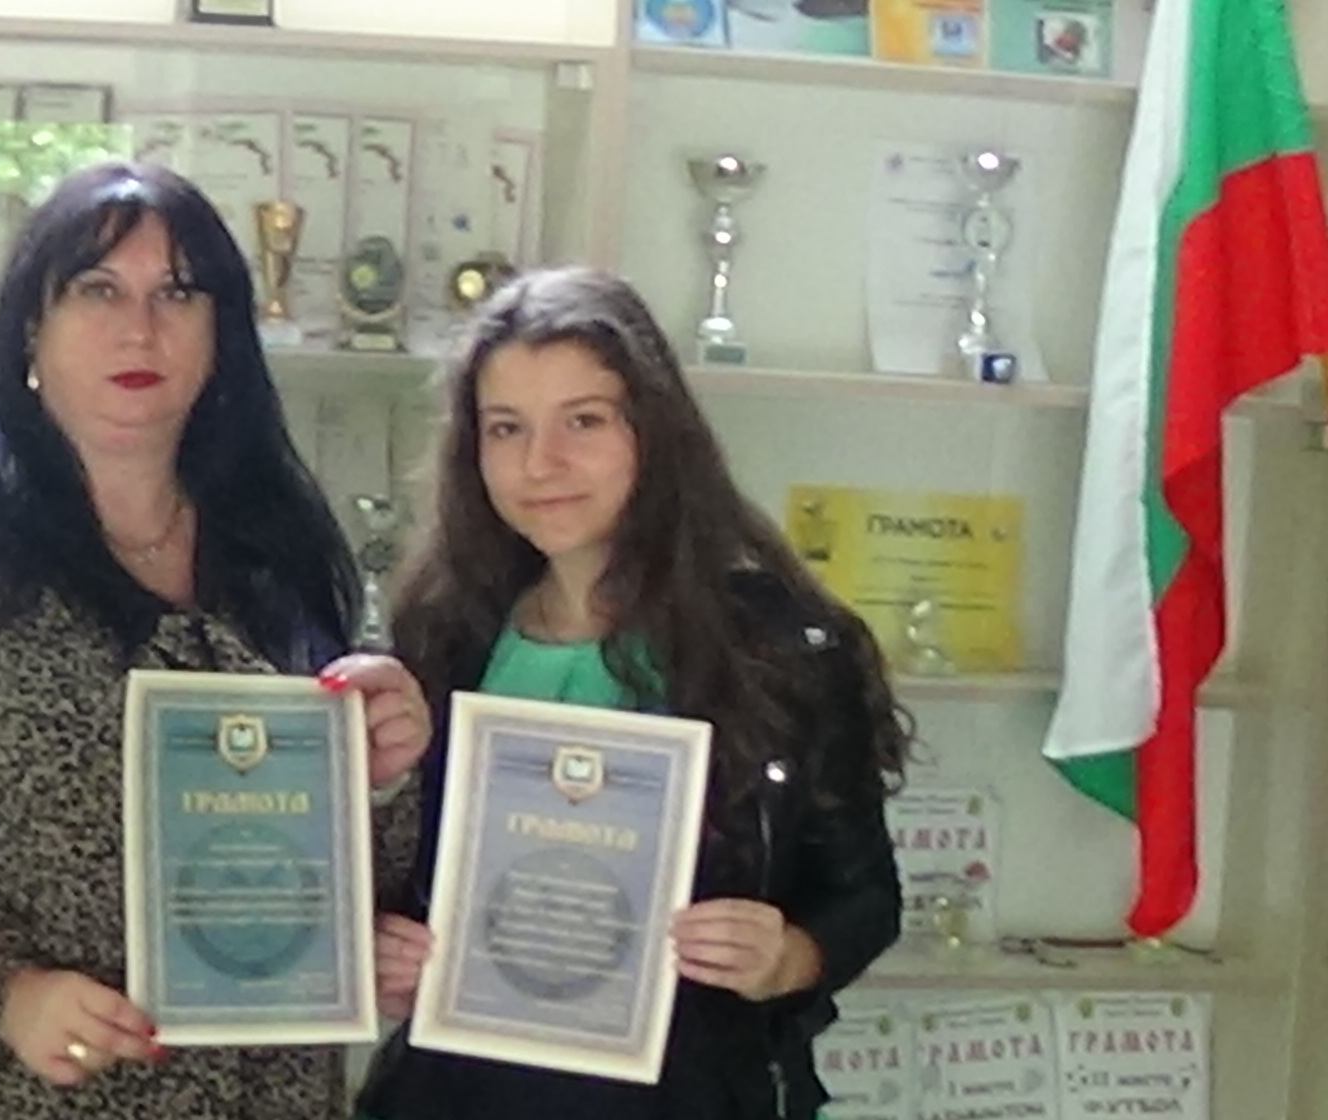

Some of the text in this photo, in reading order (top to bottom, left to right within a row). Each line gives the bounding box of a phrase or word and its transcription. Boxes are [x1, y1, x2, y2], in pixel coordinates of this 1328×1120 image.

[867, 513, 973, 539] ГРАМОТА
[181, 790, 311, 814] ГРАМОТА
[506, 811, 639, 852] ГРАМОТА
[893, 827, 987, 850] АМОТА
[919, 1033, 1043, 1065] РАМОТА
[1067, 1029, 1194, 1053] ГРАМОТА
[824, 1044, 902, 1071] МОТА
